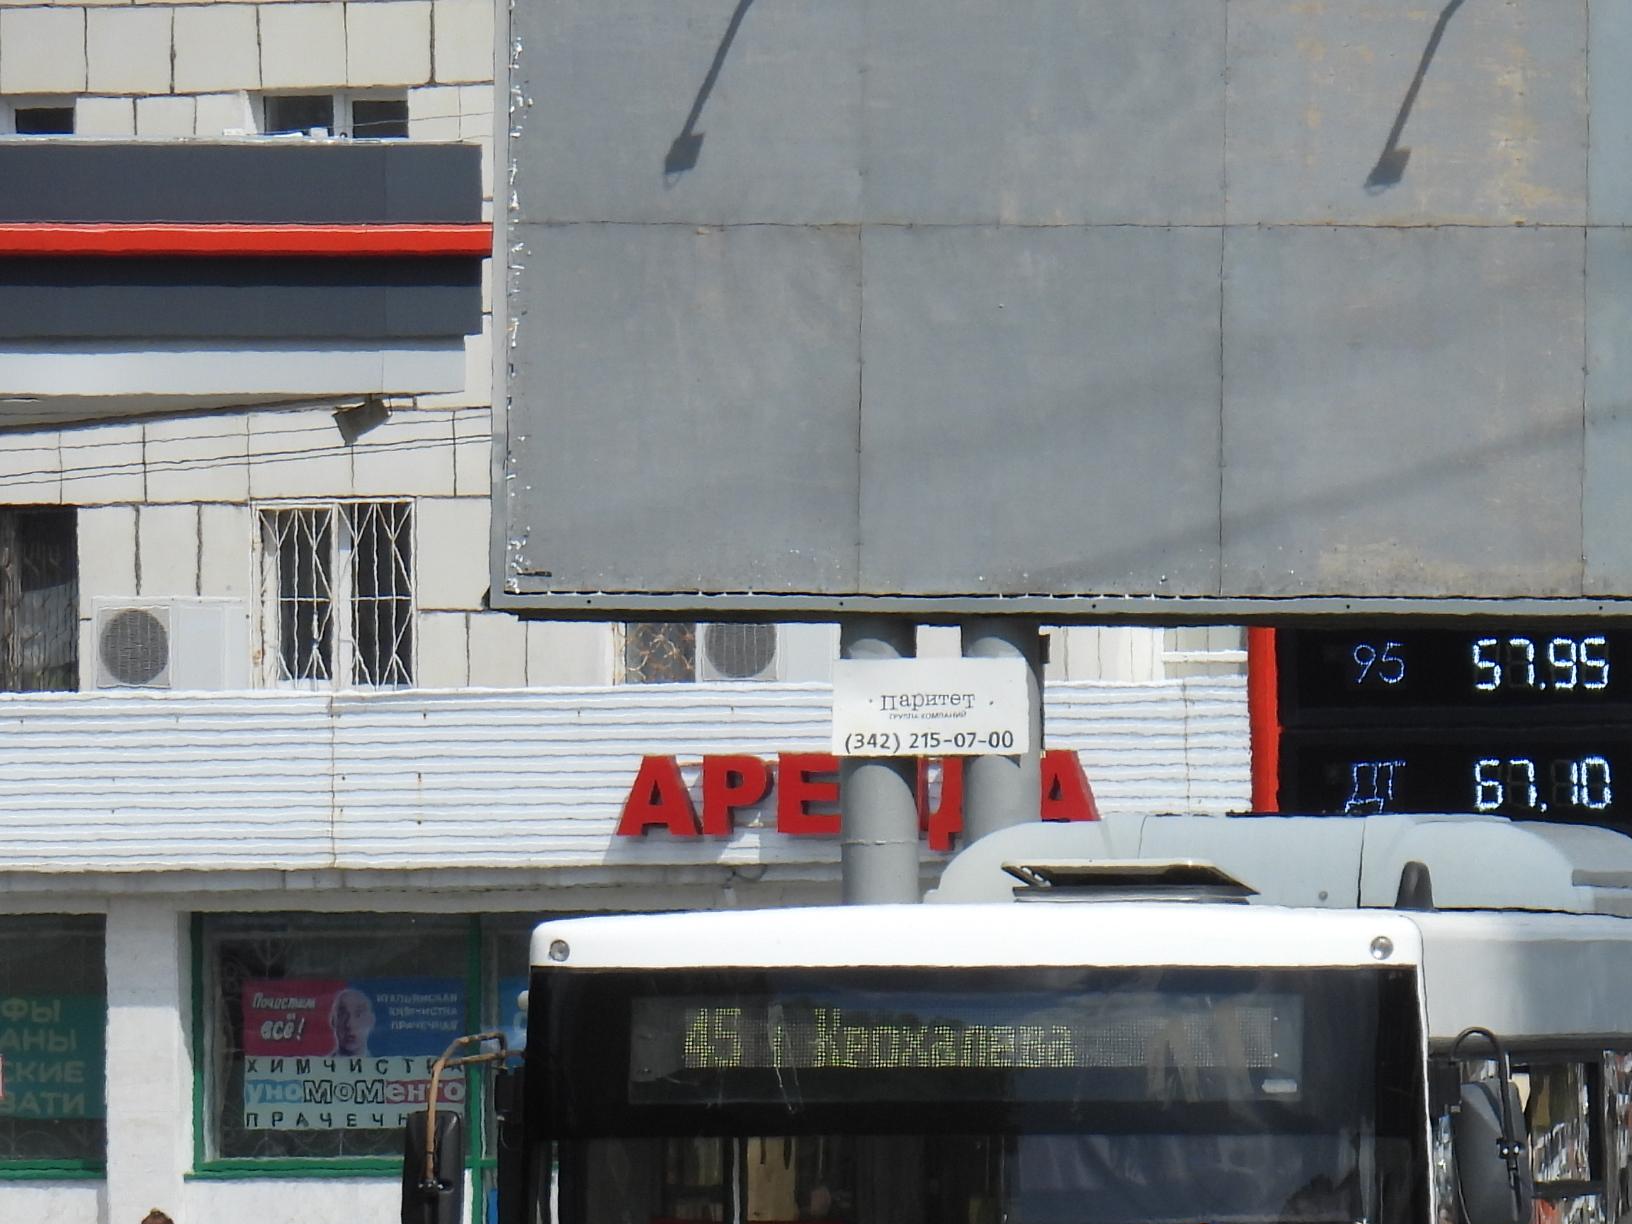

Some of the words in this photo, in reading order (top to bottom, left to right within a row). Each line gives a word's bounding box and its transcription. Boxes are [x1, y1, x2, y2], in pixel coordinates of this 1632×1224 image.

[1354, 641, 1404, 684] 95
[1473, 637, 1610, 690] 57.95
[880, 693, 976, 712] Паритет
[845, 732, 900, 754] (342)
[909, 730, 1013, 749] 215-07-00
[616, 750, 1099, 852] АРЕА
[1345, 759, 1406, 813] ДТ
[685, 1008, 742, 1067] 45
